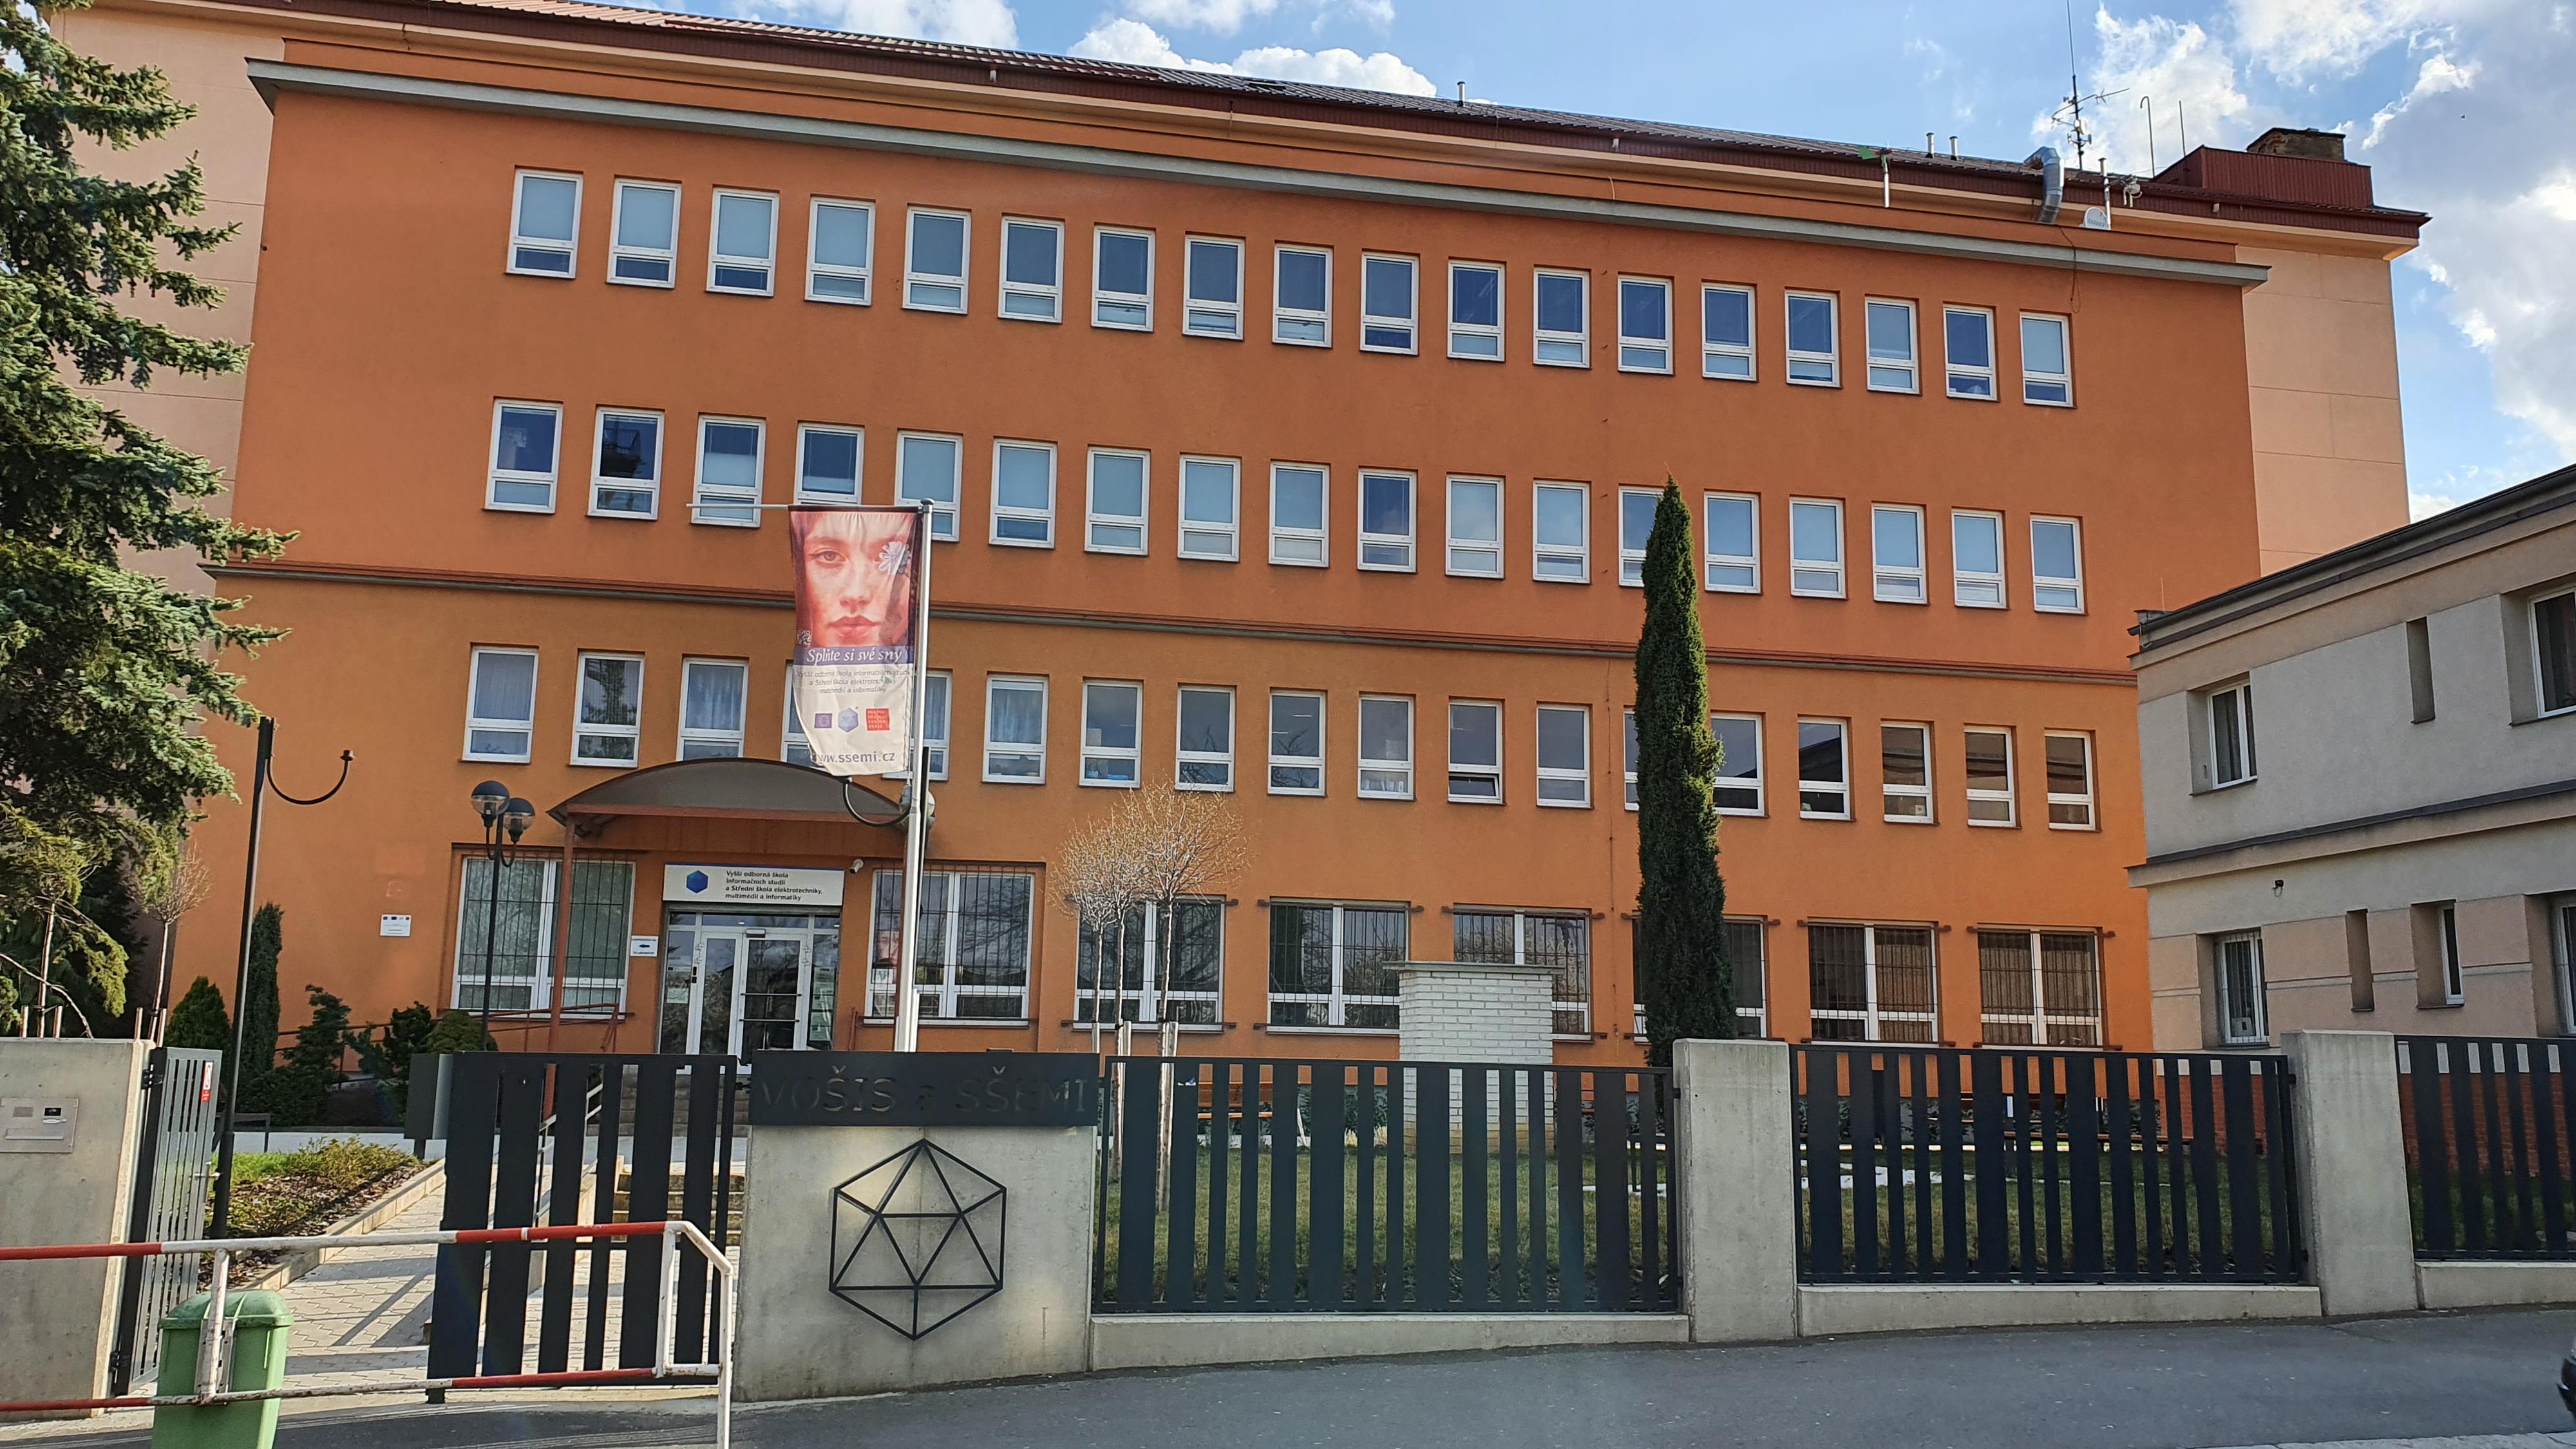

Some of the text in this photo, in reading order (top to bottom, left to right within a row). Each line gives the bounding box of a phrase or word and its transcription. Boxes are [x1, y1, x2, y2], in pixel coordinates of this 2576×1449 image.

[844, 649, 855, 661] si
[857, 647, 876, 661] své
[877, 650, 902, 664] sny
[761, 1065, 896, 1113] VOŠIS
